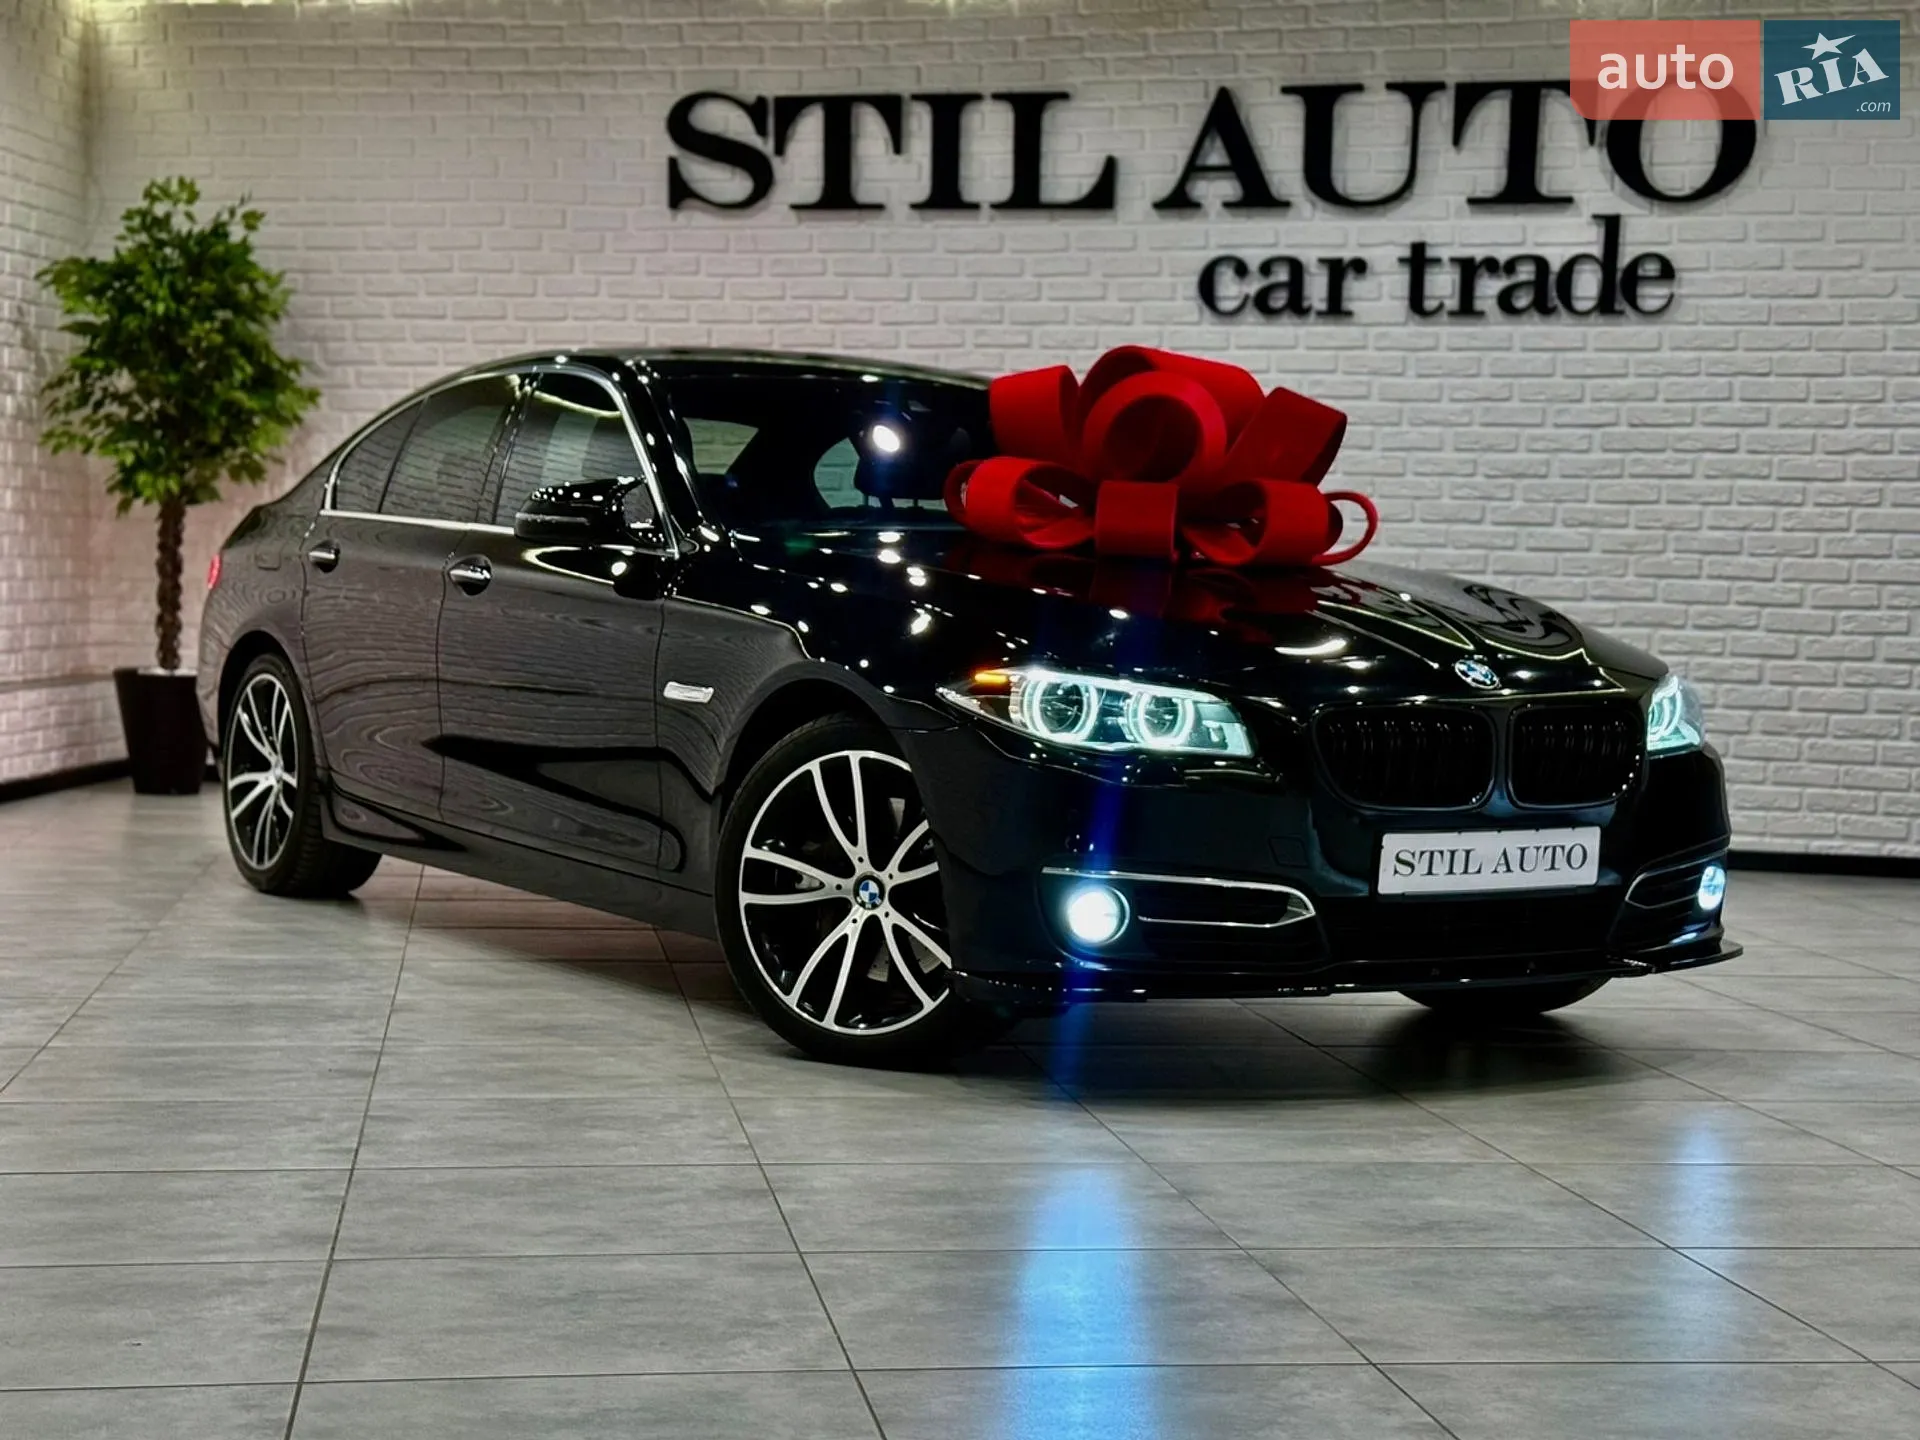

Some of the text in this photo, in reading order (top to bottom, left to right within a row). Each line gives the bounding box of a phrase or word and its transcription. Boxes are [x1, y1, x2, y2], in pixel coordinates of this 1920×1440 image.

[666, 74, 1758, 211] STIL AUTO
[1198, 213, 1676, 317] car trade
[1392, 843, 1588, 877] STIL AUTO
